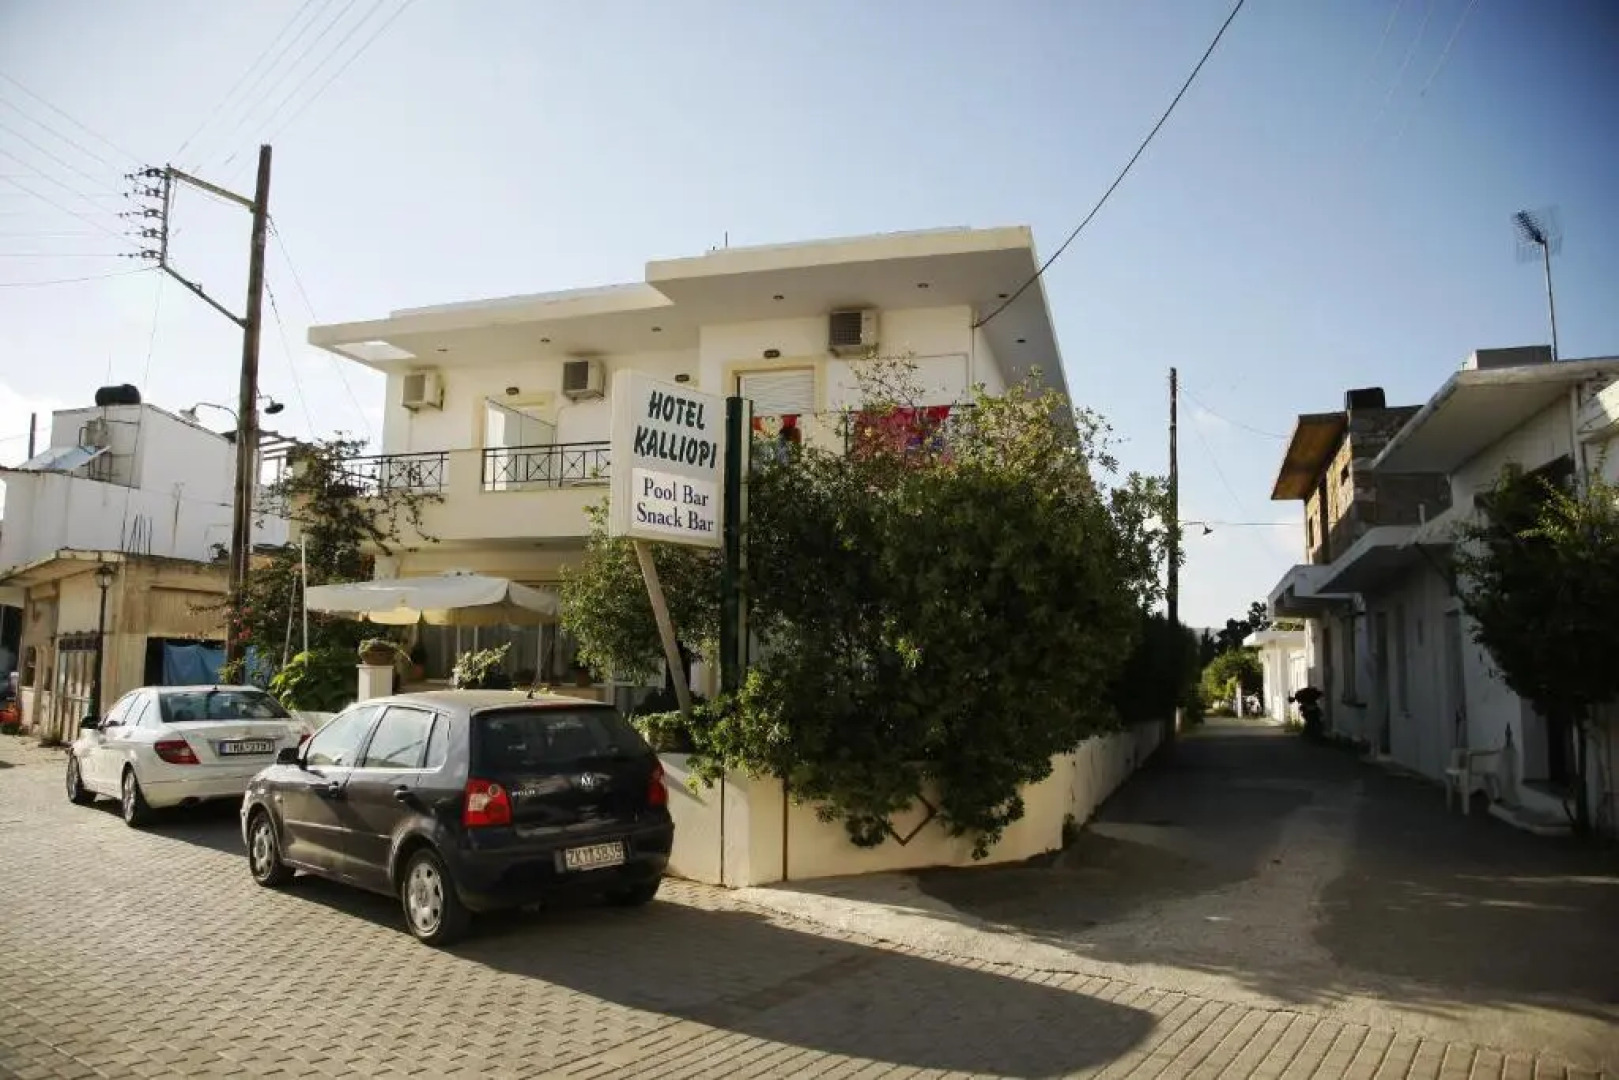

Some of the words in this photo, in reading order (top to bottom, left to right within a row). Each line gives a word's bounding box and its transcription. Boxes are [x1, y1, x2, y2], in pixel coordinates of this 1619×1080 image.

[648, 390, 706, 430] HOTEL
[633, 425, 717, 469] KALLIOPI
[643, 476, 677, 502] Pool
[682, 485, 709, 507] Bar
[636, 502, 682, 529] Snack
[687, 510, 714, 532] Bar
